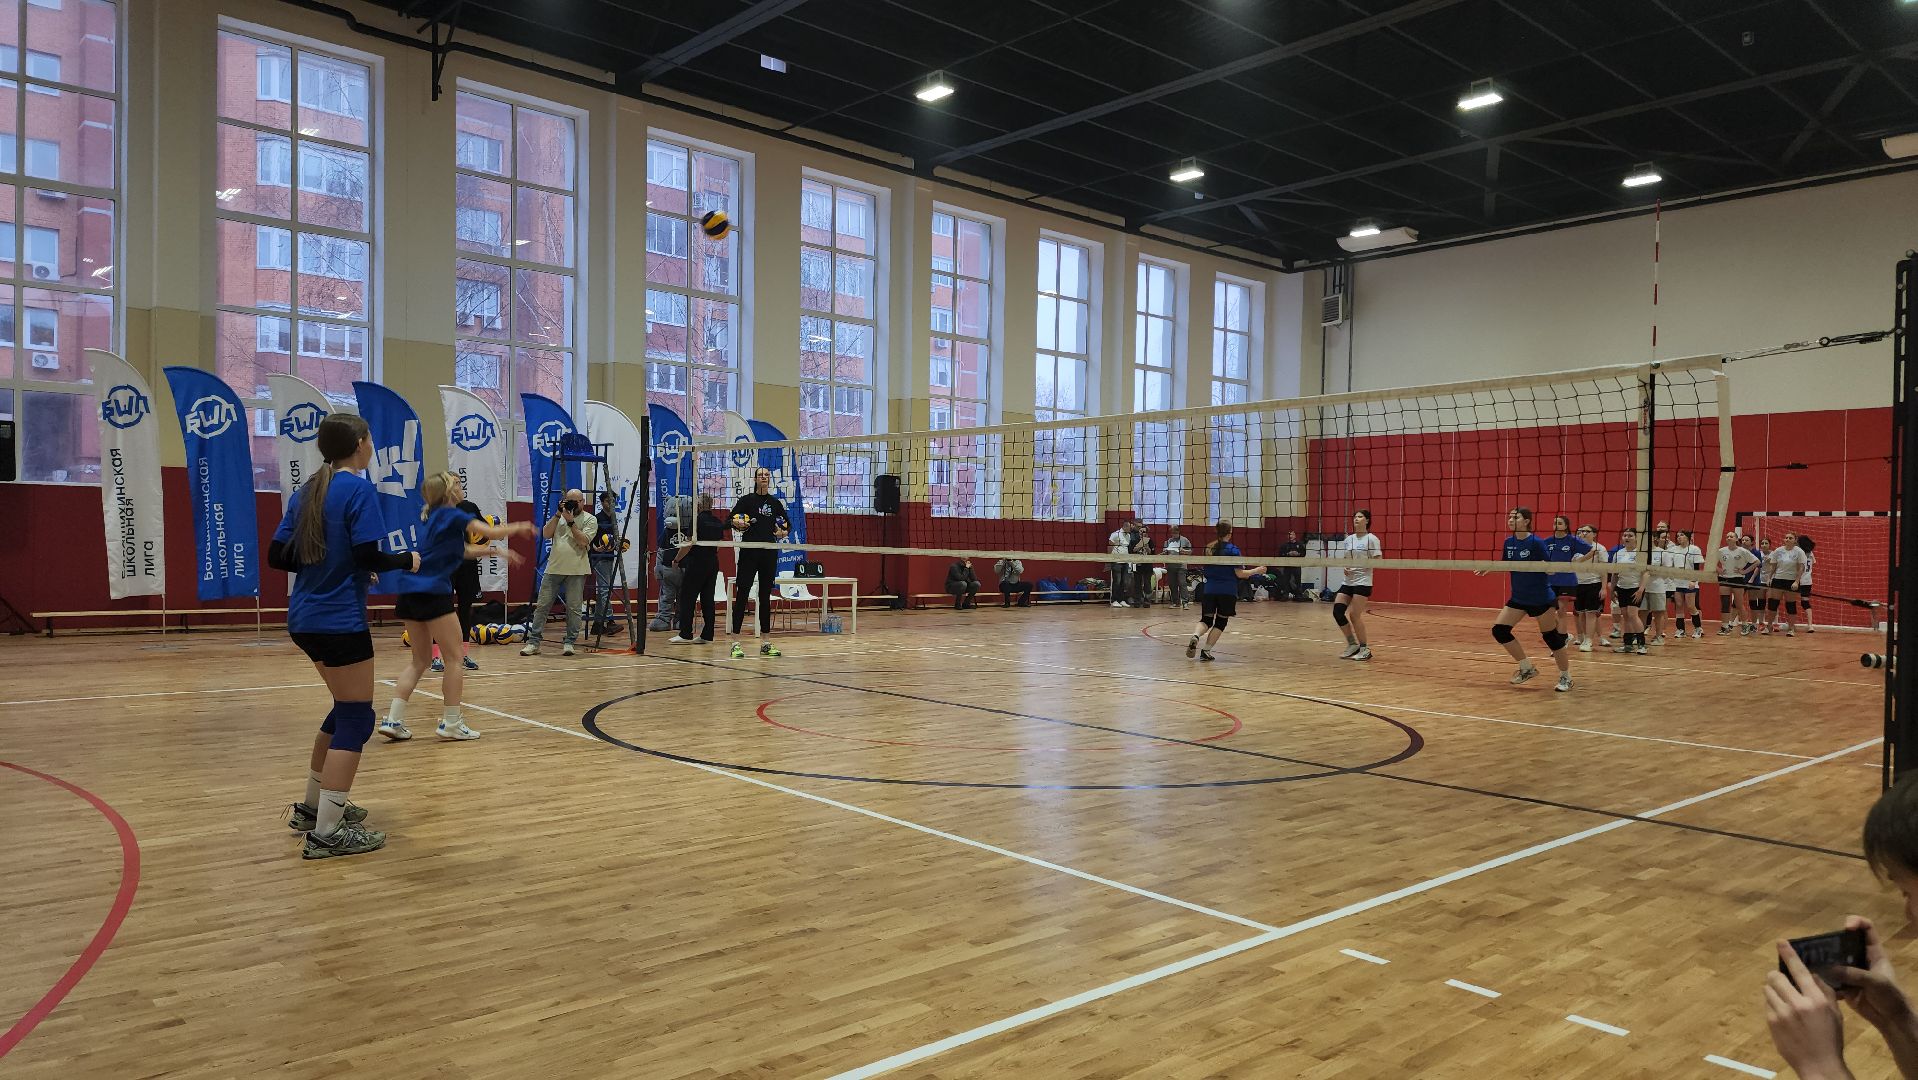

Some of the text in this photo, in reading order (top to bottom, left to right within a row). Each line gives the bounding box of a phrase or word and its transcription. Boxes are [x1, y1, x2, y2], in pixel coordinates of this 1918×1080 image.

[144, 540, 154, 577] лига
[214, 502, 229, 580] школьная
[233, 542, 246, 578] лига
